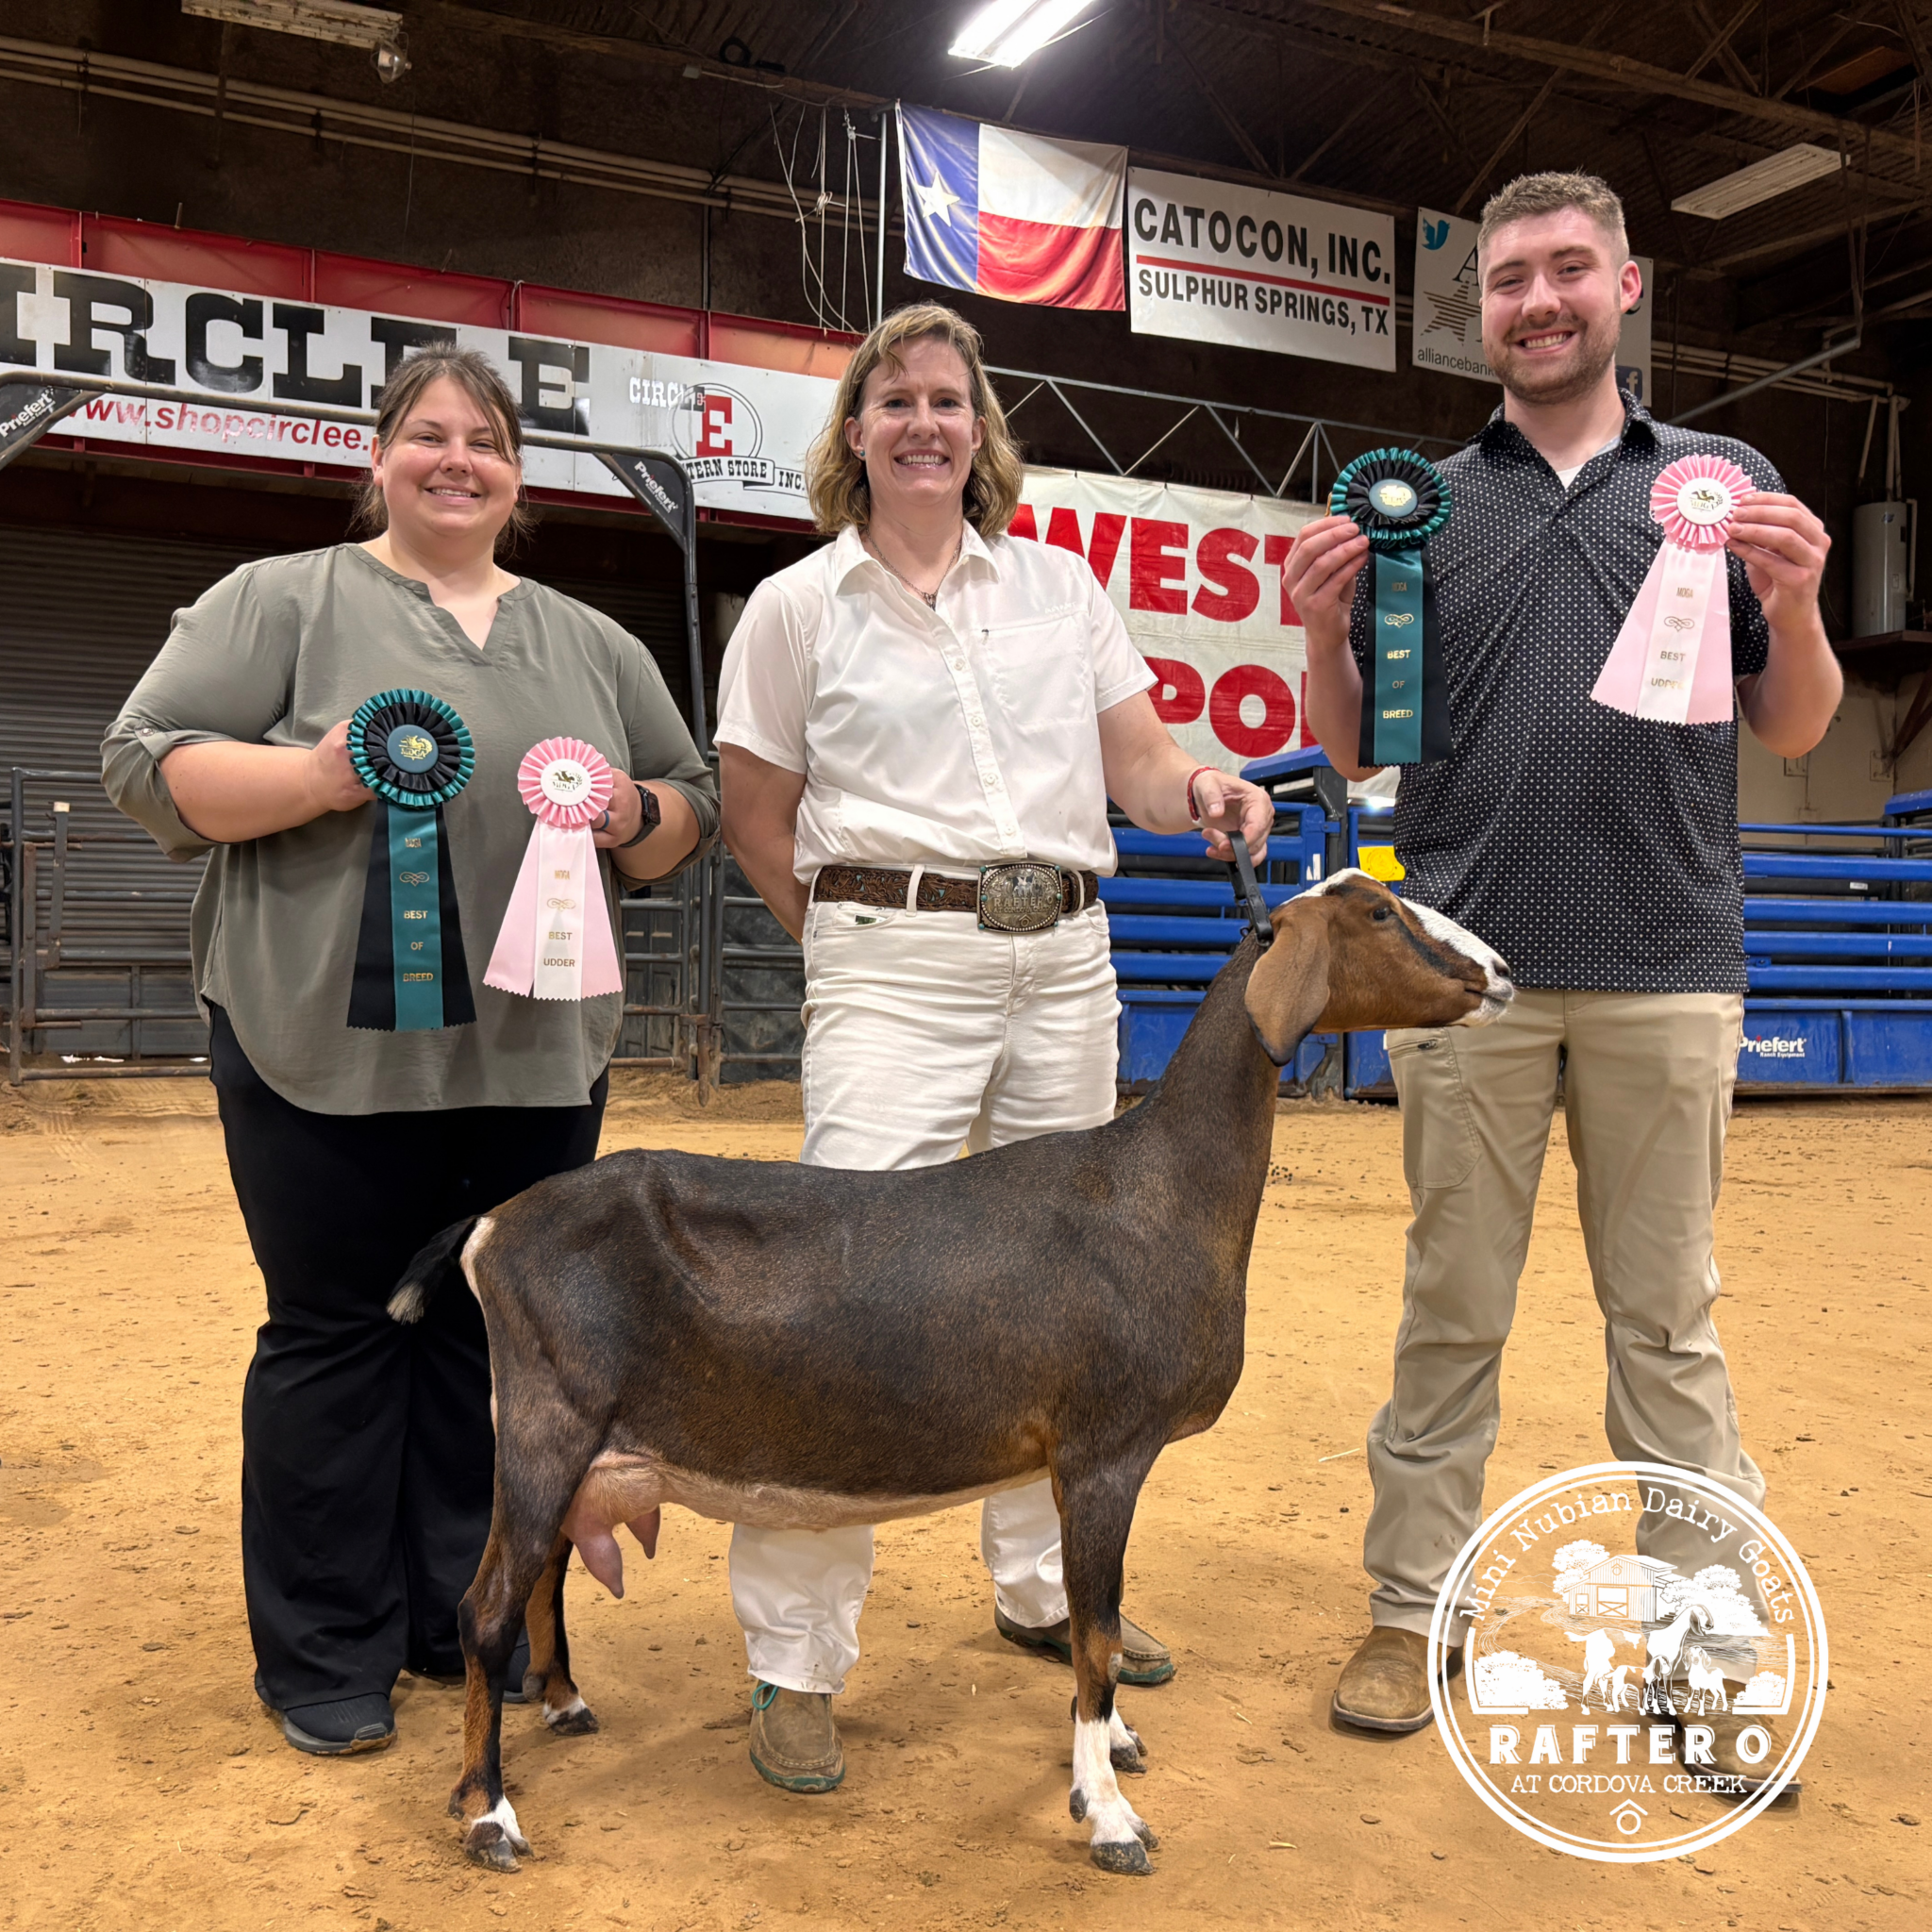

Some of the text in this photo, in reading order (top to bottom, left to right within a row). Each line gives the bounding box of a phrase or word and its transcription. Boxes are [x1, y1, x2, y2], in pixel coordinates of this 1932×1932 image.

[1134, 198, 1318, 279] CATOCON,
[1328, 232, 1391, 284] INC.
[1139, 269, 1389, 336] SULPHUR SPRINGS, TX
[508, 336, 591, 437] E
[629, 376, 706, 412] CIRCLE
[695, 394, 733, 458] E
[727, 459, 767, 479] STORE
[778, 471, 806, 491] INC.
[634, 460, 675, 510] Priefert
[1387, 649, 1411, 659] BEST
[1659, 651, 1686, 662] BEST
[1391, 680, 1406, 690] OF
[1382, 709, 1413, 720] BREED
[403, 909, 428, 921] BEST
[548, 930, 574, 941] BEST
[410, 941, 424, 951] OF
[543, 958, 575, 968] UDDER
[402, 972, 434, 983] BREED
